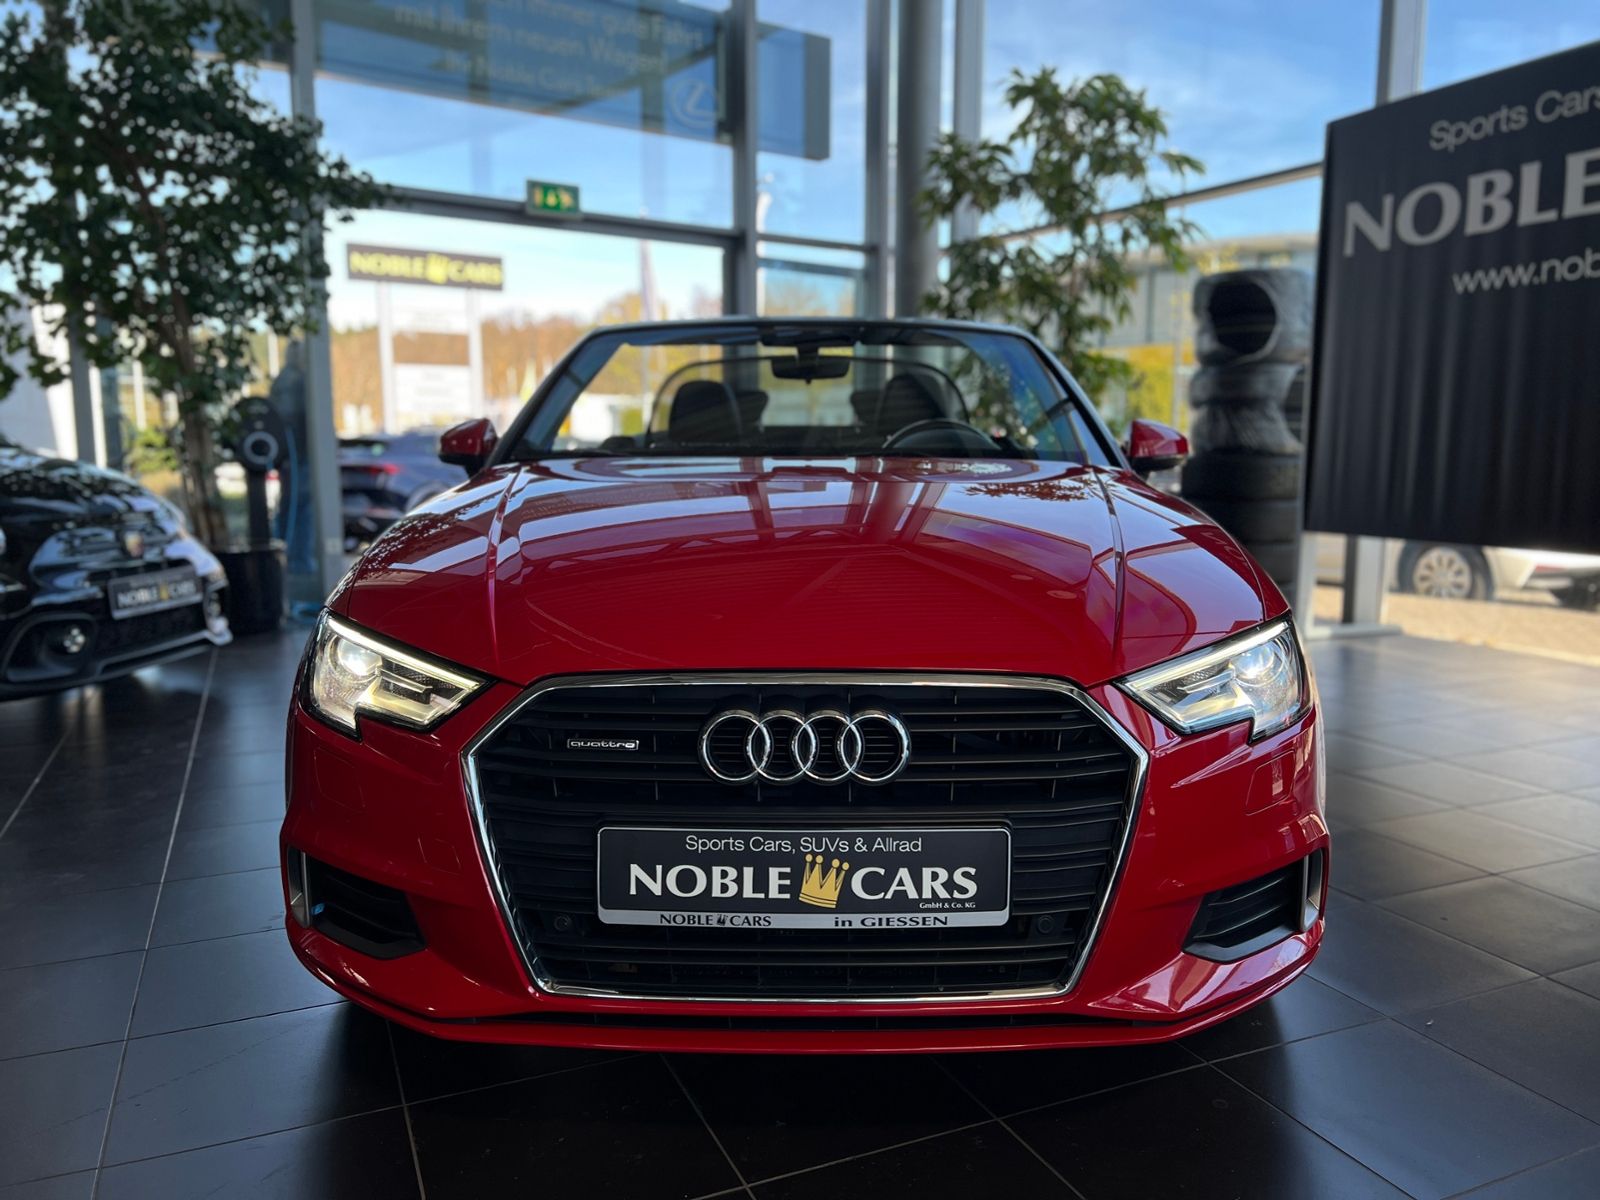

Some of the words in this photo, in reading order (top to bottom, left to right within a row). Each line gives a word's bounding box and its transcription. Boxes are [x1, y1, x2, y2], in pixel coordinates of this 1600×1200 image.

[1429, 104, 1528, 152] Sports
[1343, 146, 1600, 258] NOBLE
[351, 251, 425, 279] NOBLE
[448, 259, 503, 286] CARS
[570, 740, 636, 749] quattro
[685, 835, 745, 854] Sports
[750, 836, 796, 855] Cars,
[800, 836, 850, 853] SUVs
[854, 837, 868, 853] &
[872, 836, 922, 853] Allrad
[629, 863, 792, 899] NOBLE
[851, 866, 978, 900] CARS
[919, 901, 943, 909] GmbH
[965, 901, 976, 909] KG
[659, 913, 714, 926] NOBLE
[730, 915, 772, 927] CARS
[834, 916, 853, 928] in
[860, 915, 949, 928] GIESSEN
